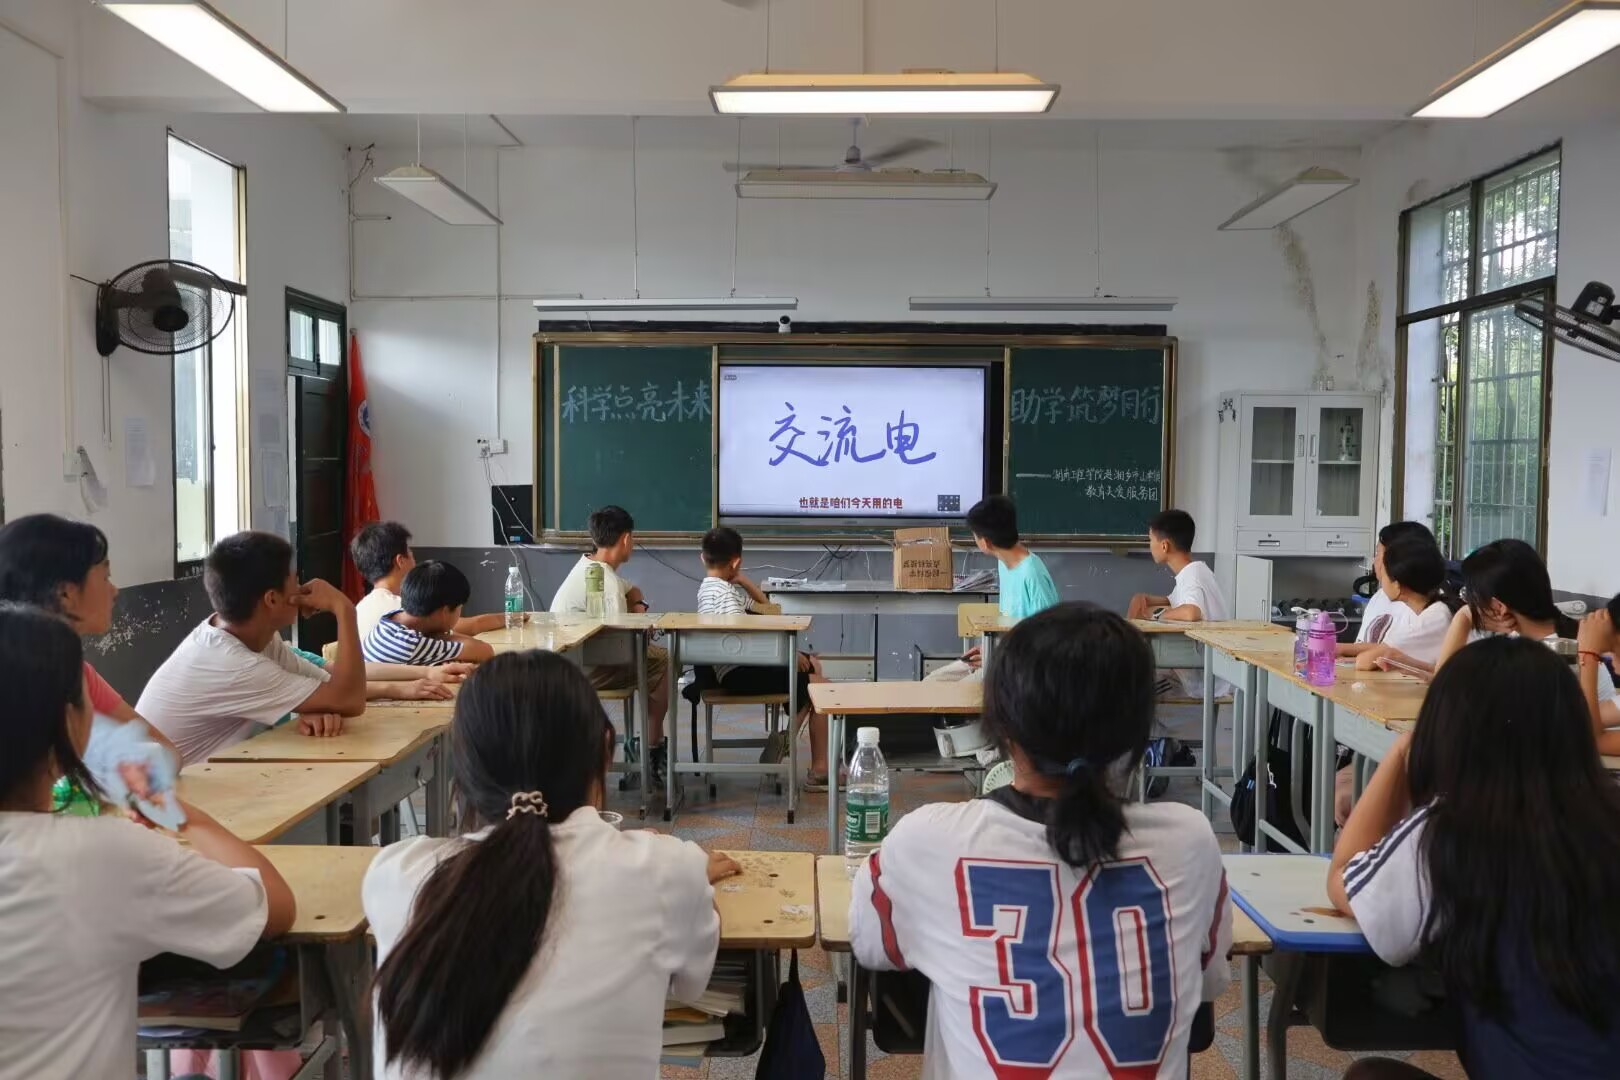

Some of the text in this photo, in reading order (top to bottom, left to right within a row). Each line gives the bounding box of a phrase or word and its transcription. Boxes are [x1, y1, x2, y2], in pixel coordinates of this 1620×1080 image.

[562, 380, 712, 424] 科学点亮未来
[1011, 385, 1160, 424] 助学筑梦同行
[769, 401, 937, 467] 交流电
[799, 497, 904, 509] 也就是咱们今天用的电
[954, 856, 1178, 1080] 30
